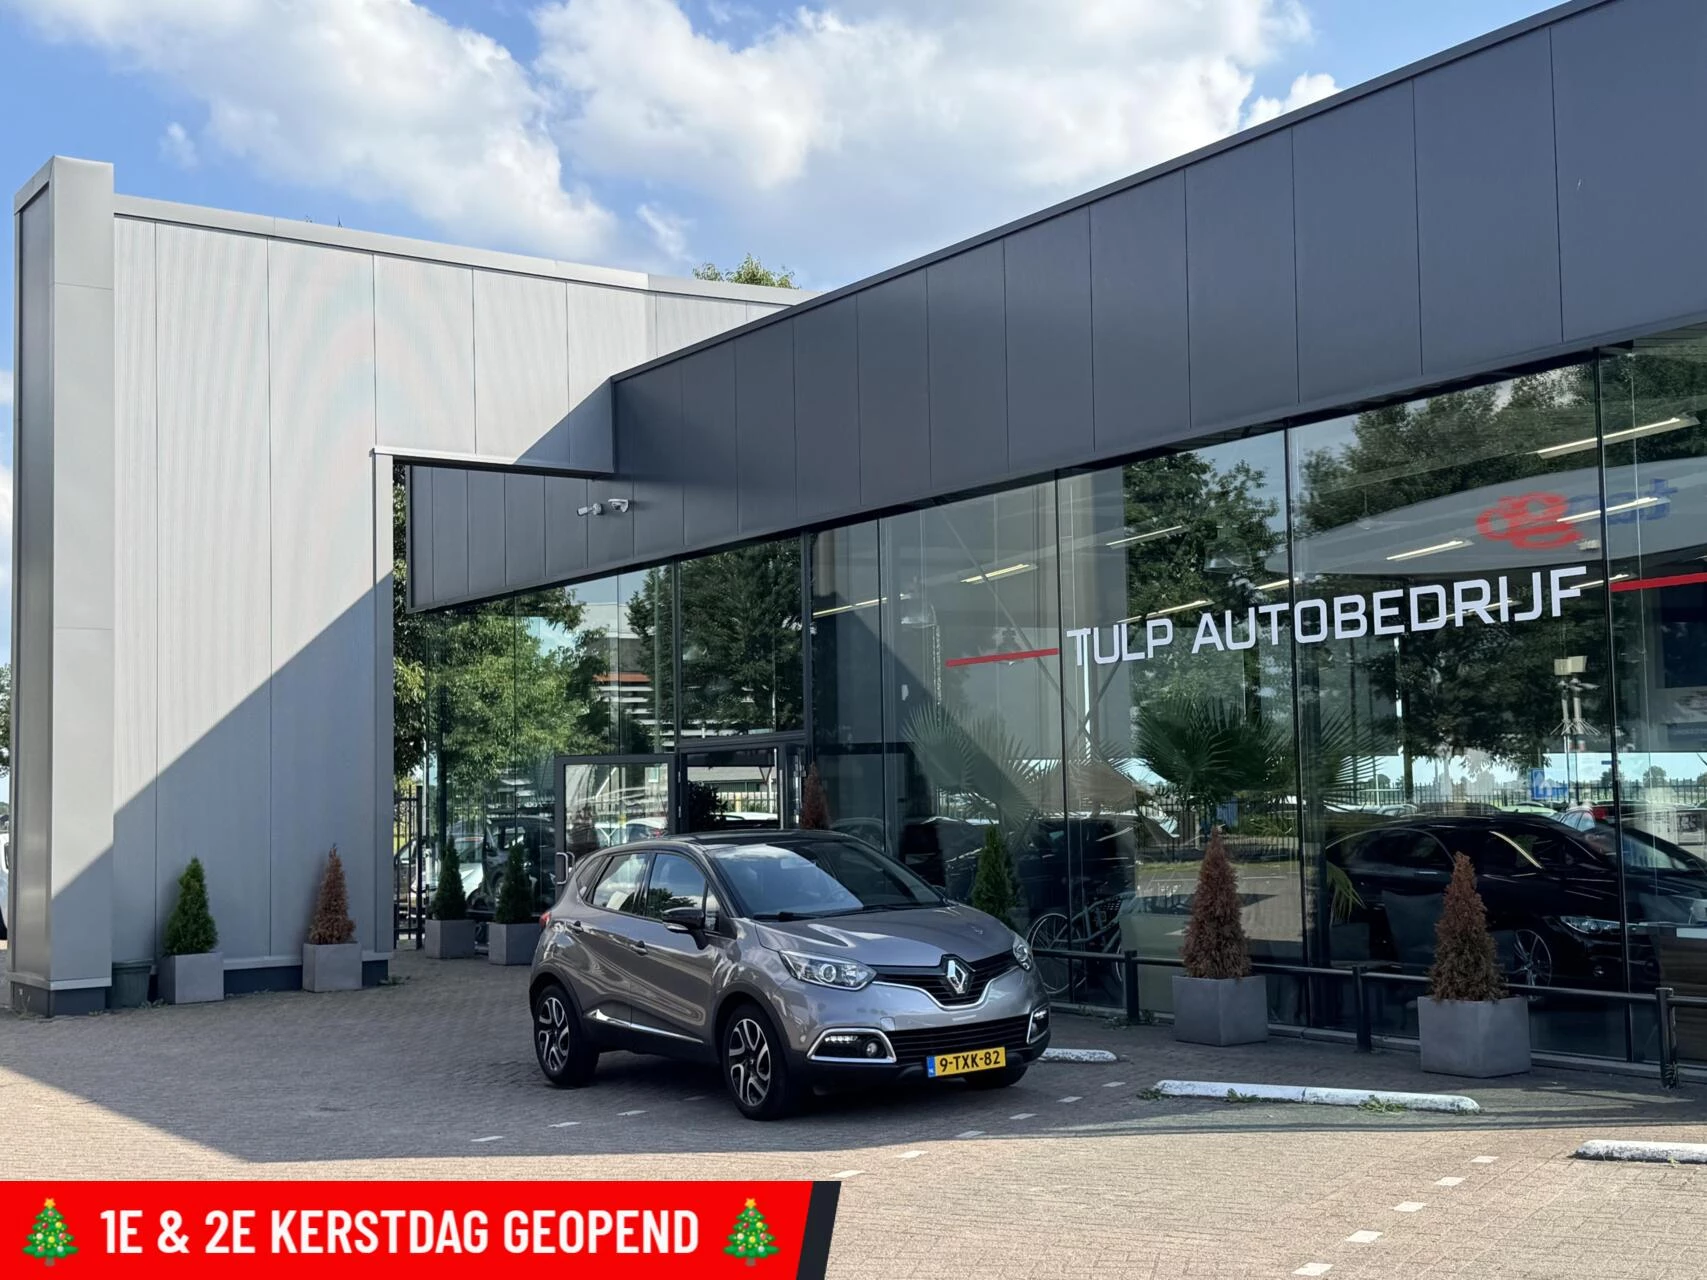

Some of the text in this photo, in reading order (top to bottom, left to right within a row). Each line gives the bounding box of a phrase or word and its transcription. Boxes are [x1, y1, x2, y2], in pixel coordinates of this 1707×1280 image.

[1066, 566, 1587, 666] TULP AUTOBEDRIJF
[939, 1050, 1001, 1072] 9-TXK-82
